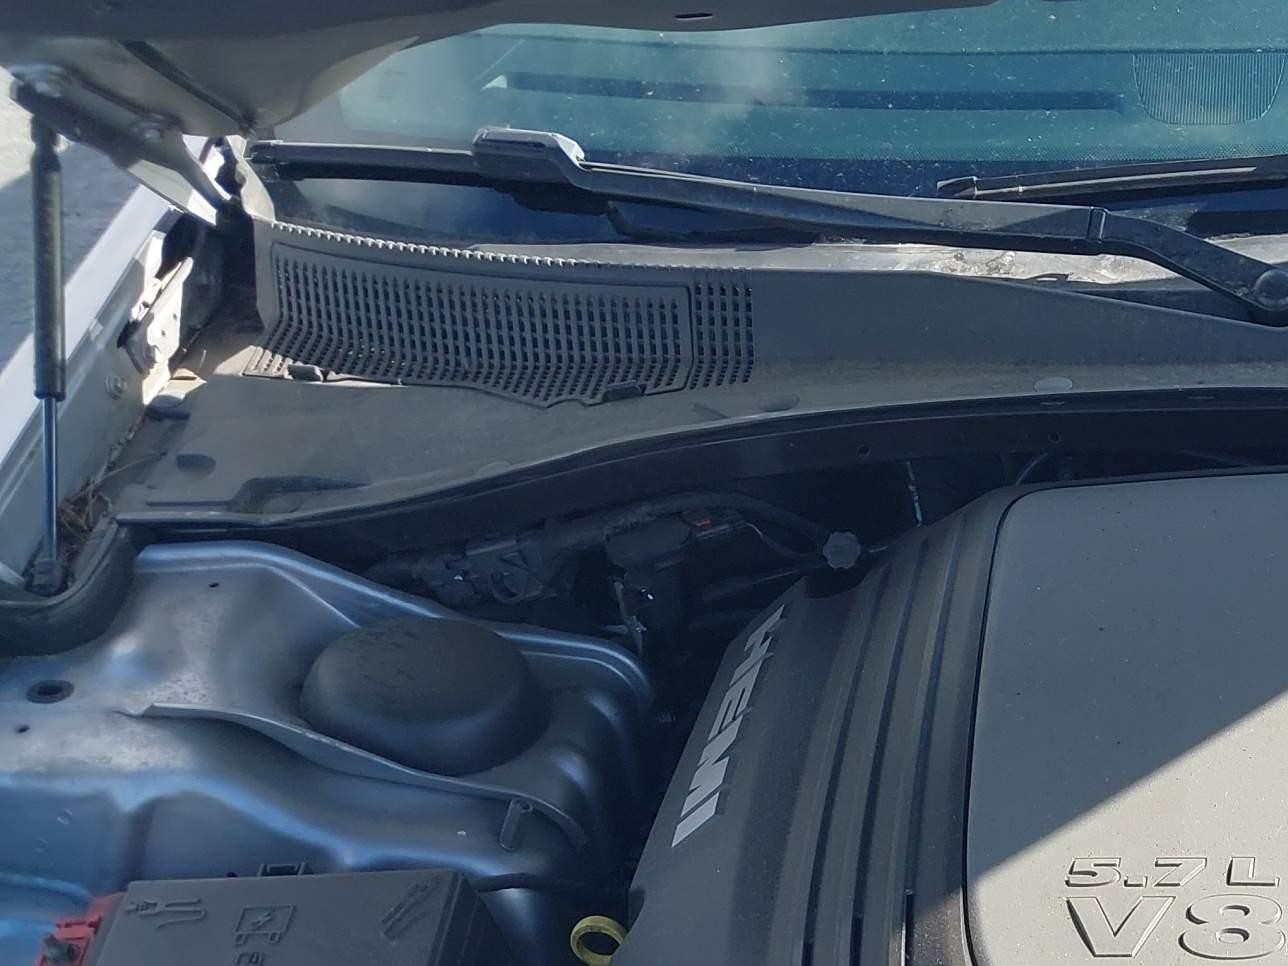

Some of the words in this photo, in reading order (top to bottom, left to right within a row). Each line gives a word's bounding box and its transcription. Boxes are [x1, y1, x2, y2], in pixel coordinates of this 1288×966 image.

[671, 604, 784, 848] HEMI
[1064, 857, 1207, 887] 5.7
[1226, 856, 1280, 887] L
[1064, 893, 1286, 960] V8
